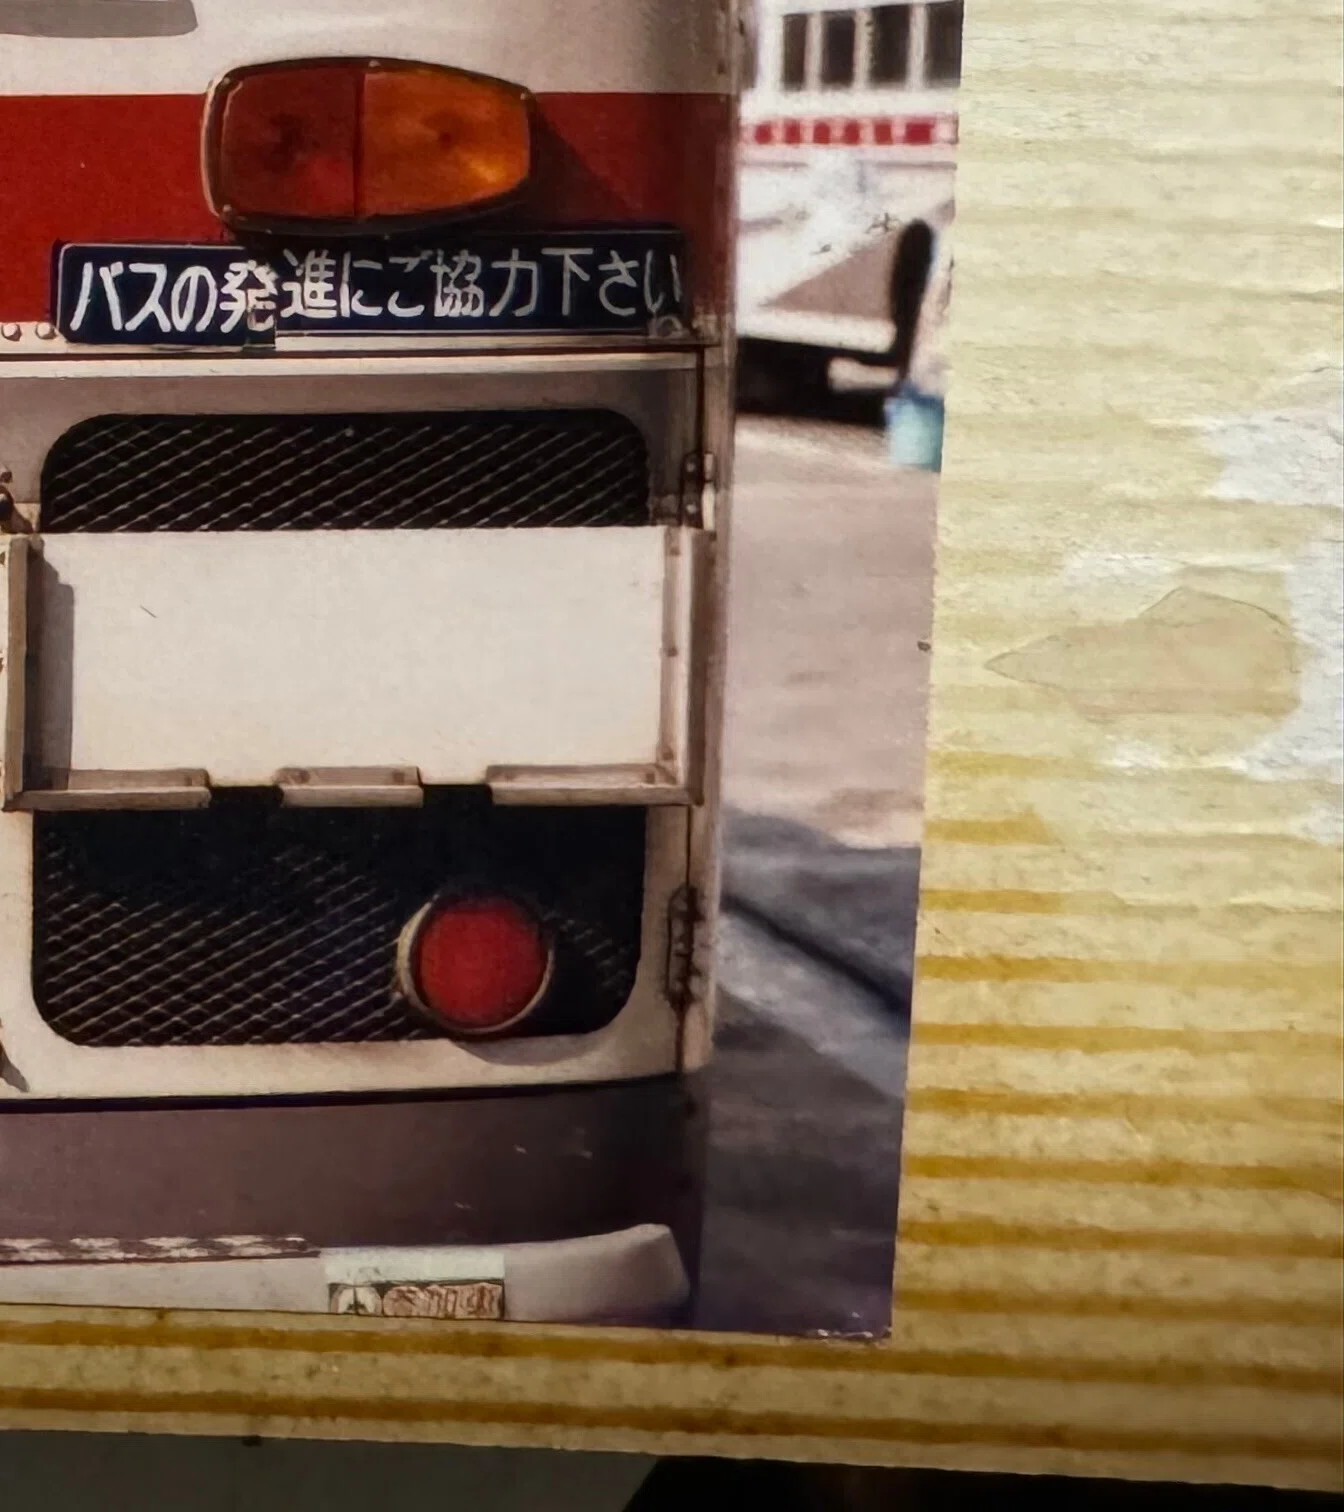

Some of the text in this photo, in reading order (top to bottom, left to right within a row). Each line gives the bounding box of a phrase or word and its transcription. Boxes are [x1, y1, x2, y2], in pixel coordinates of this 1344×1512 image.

[69, 247, 682, 334] バスの発進にご協力下さい
